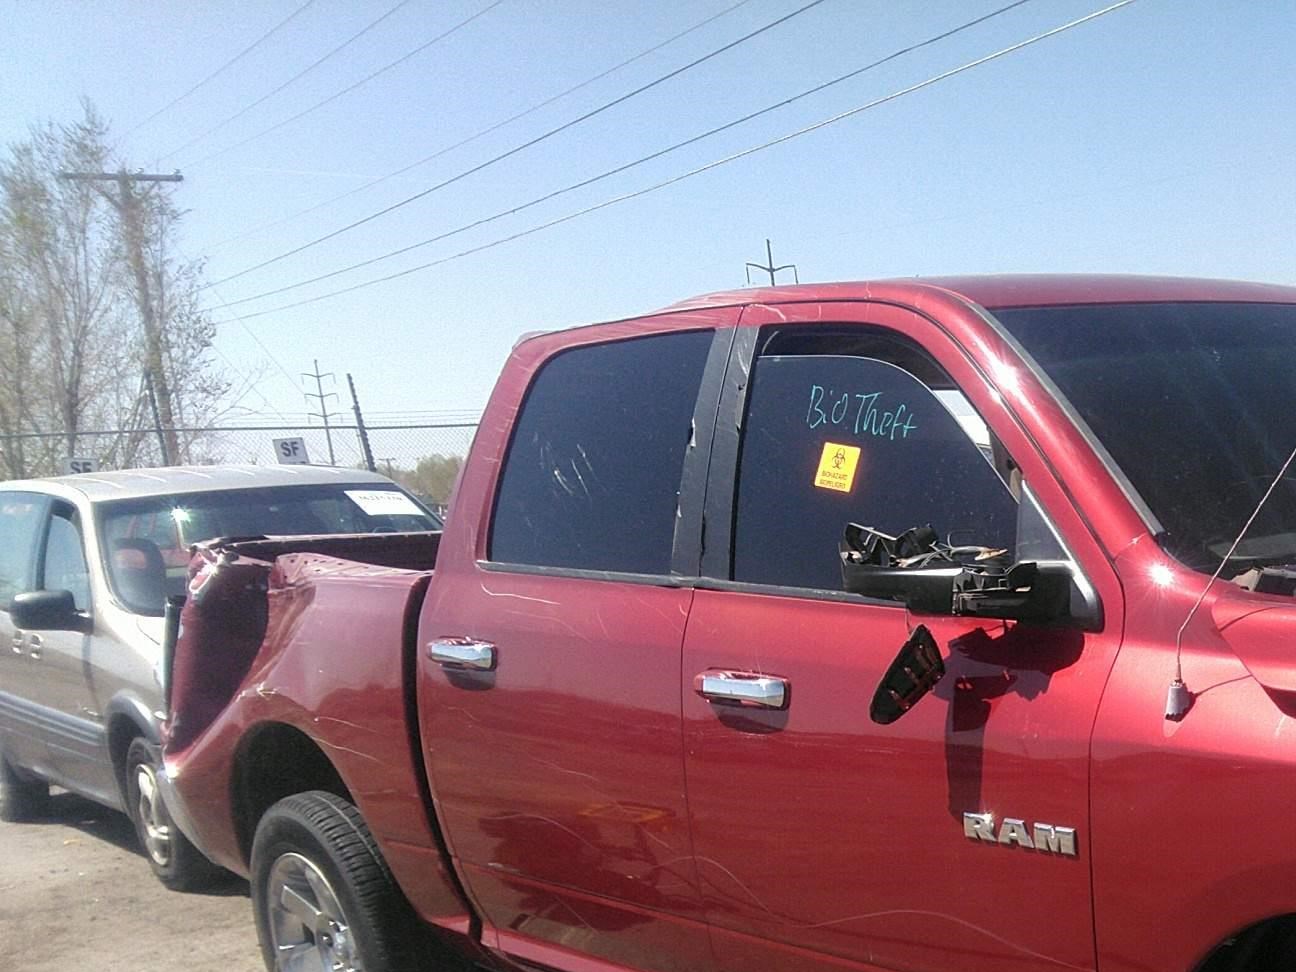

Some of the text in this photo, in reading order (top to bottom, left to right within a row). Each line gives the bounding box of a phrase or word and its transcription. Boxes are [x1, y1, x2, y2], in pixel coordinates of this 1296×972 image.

[854, 392, 917, 441] Theft
[280, 441, 299, 457] SF
[963, 811, 1077, 856] RAM
